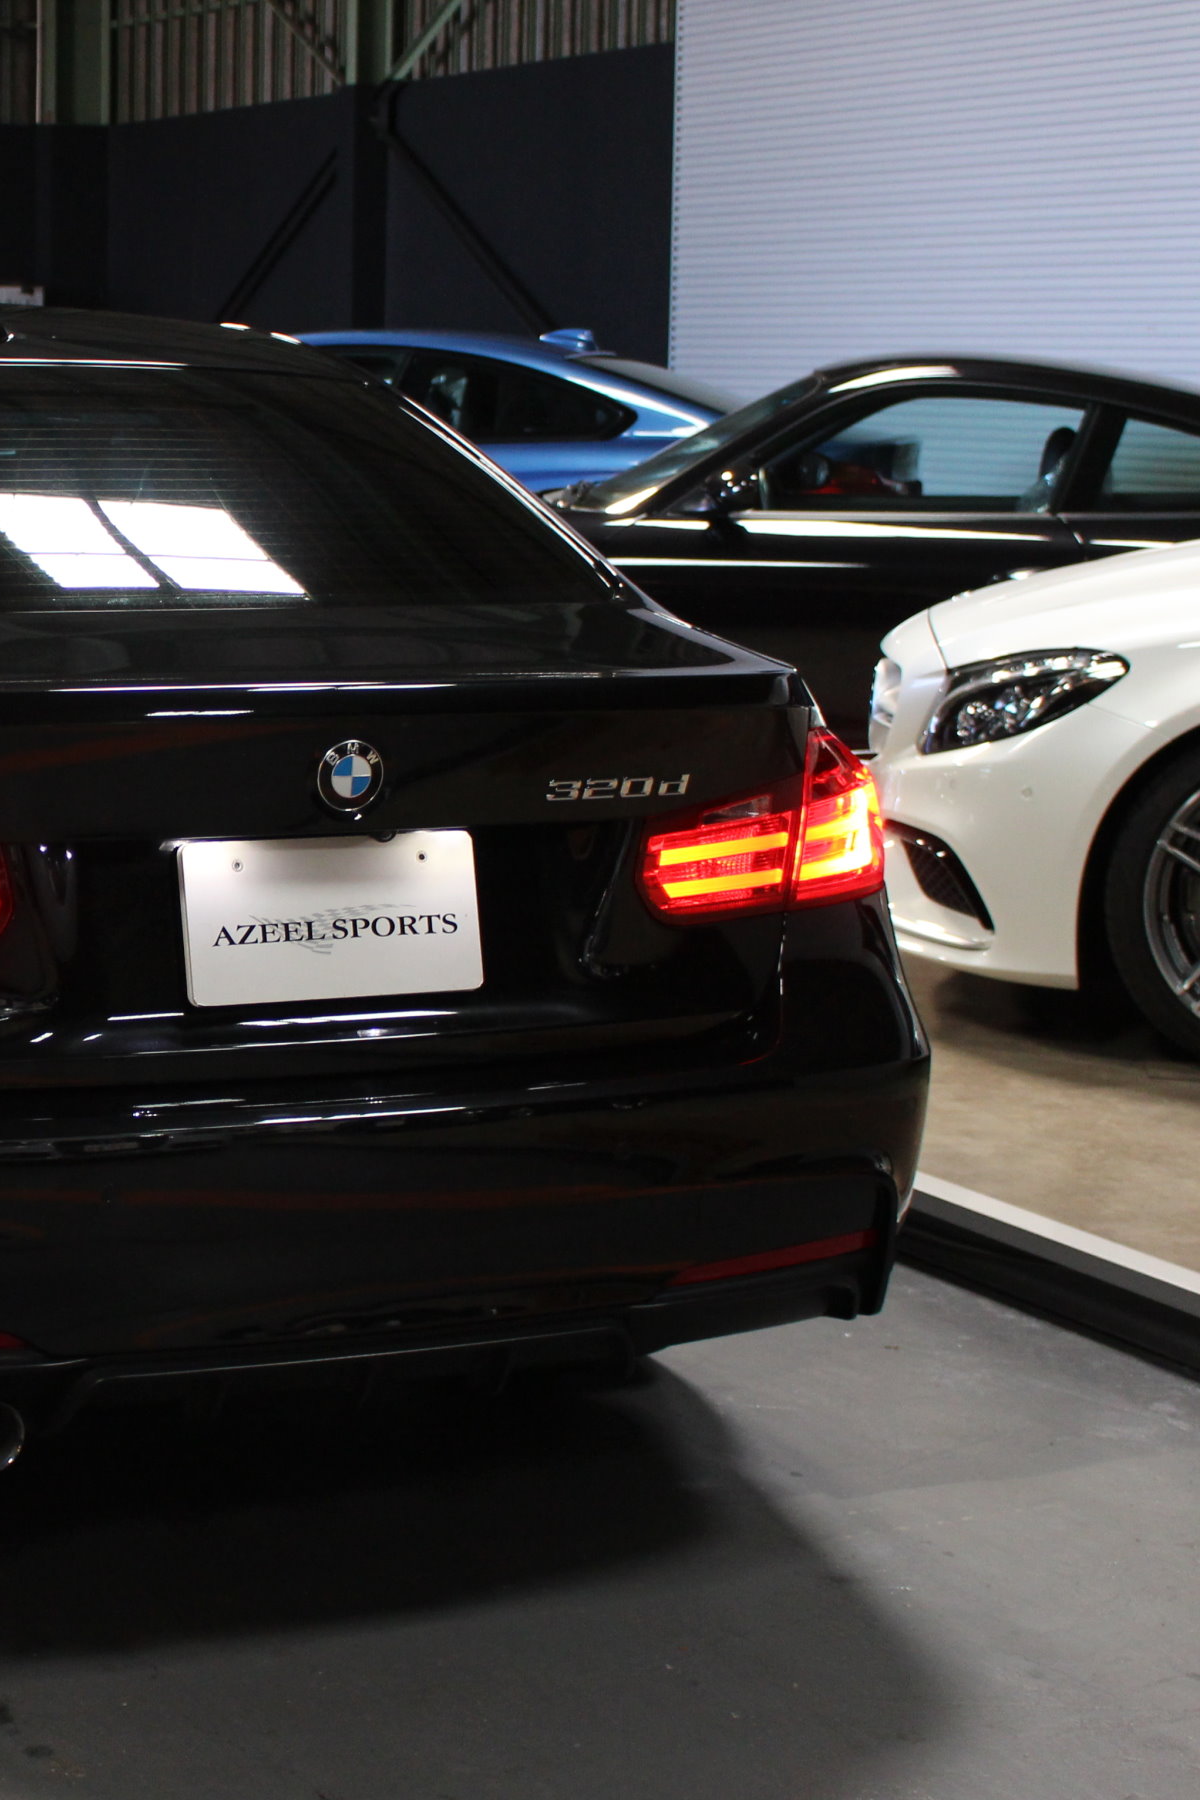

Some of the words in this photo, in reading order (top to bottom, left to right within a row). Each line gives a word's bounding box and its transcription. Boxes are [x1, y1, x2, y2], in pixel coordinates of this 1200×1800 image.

[326, 742, 379, 766] BMW
[546, 774, 690, 800] 320d
[212, 921, 327, 947] AZEEL
[331, 913, 459, 940] SPORTS
